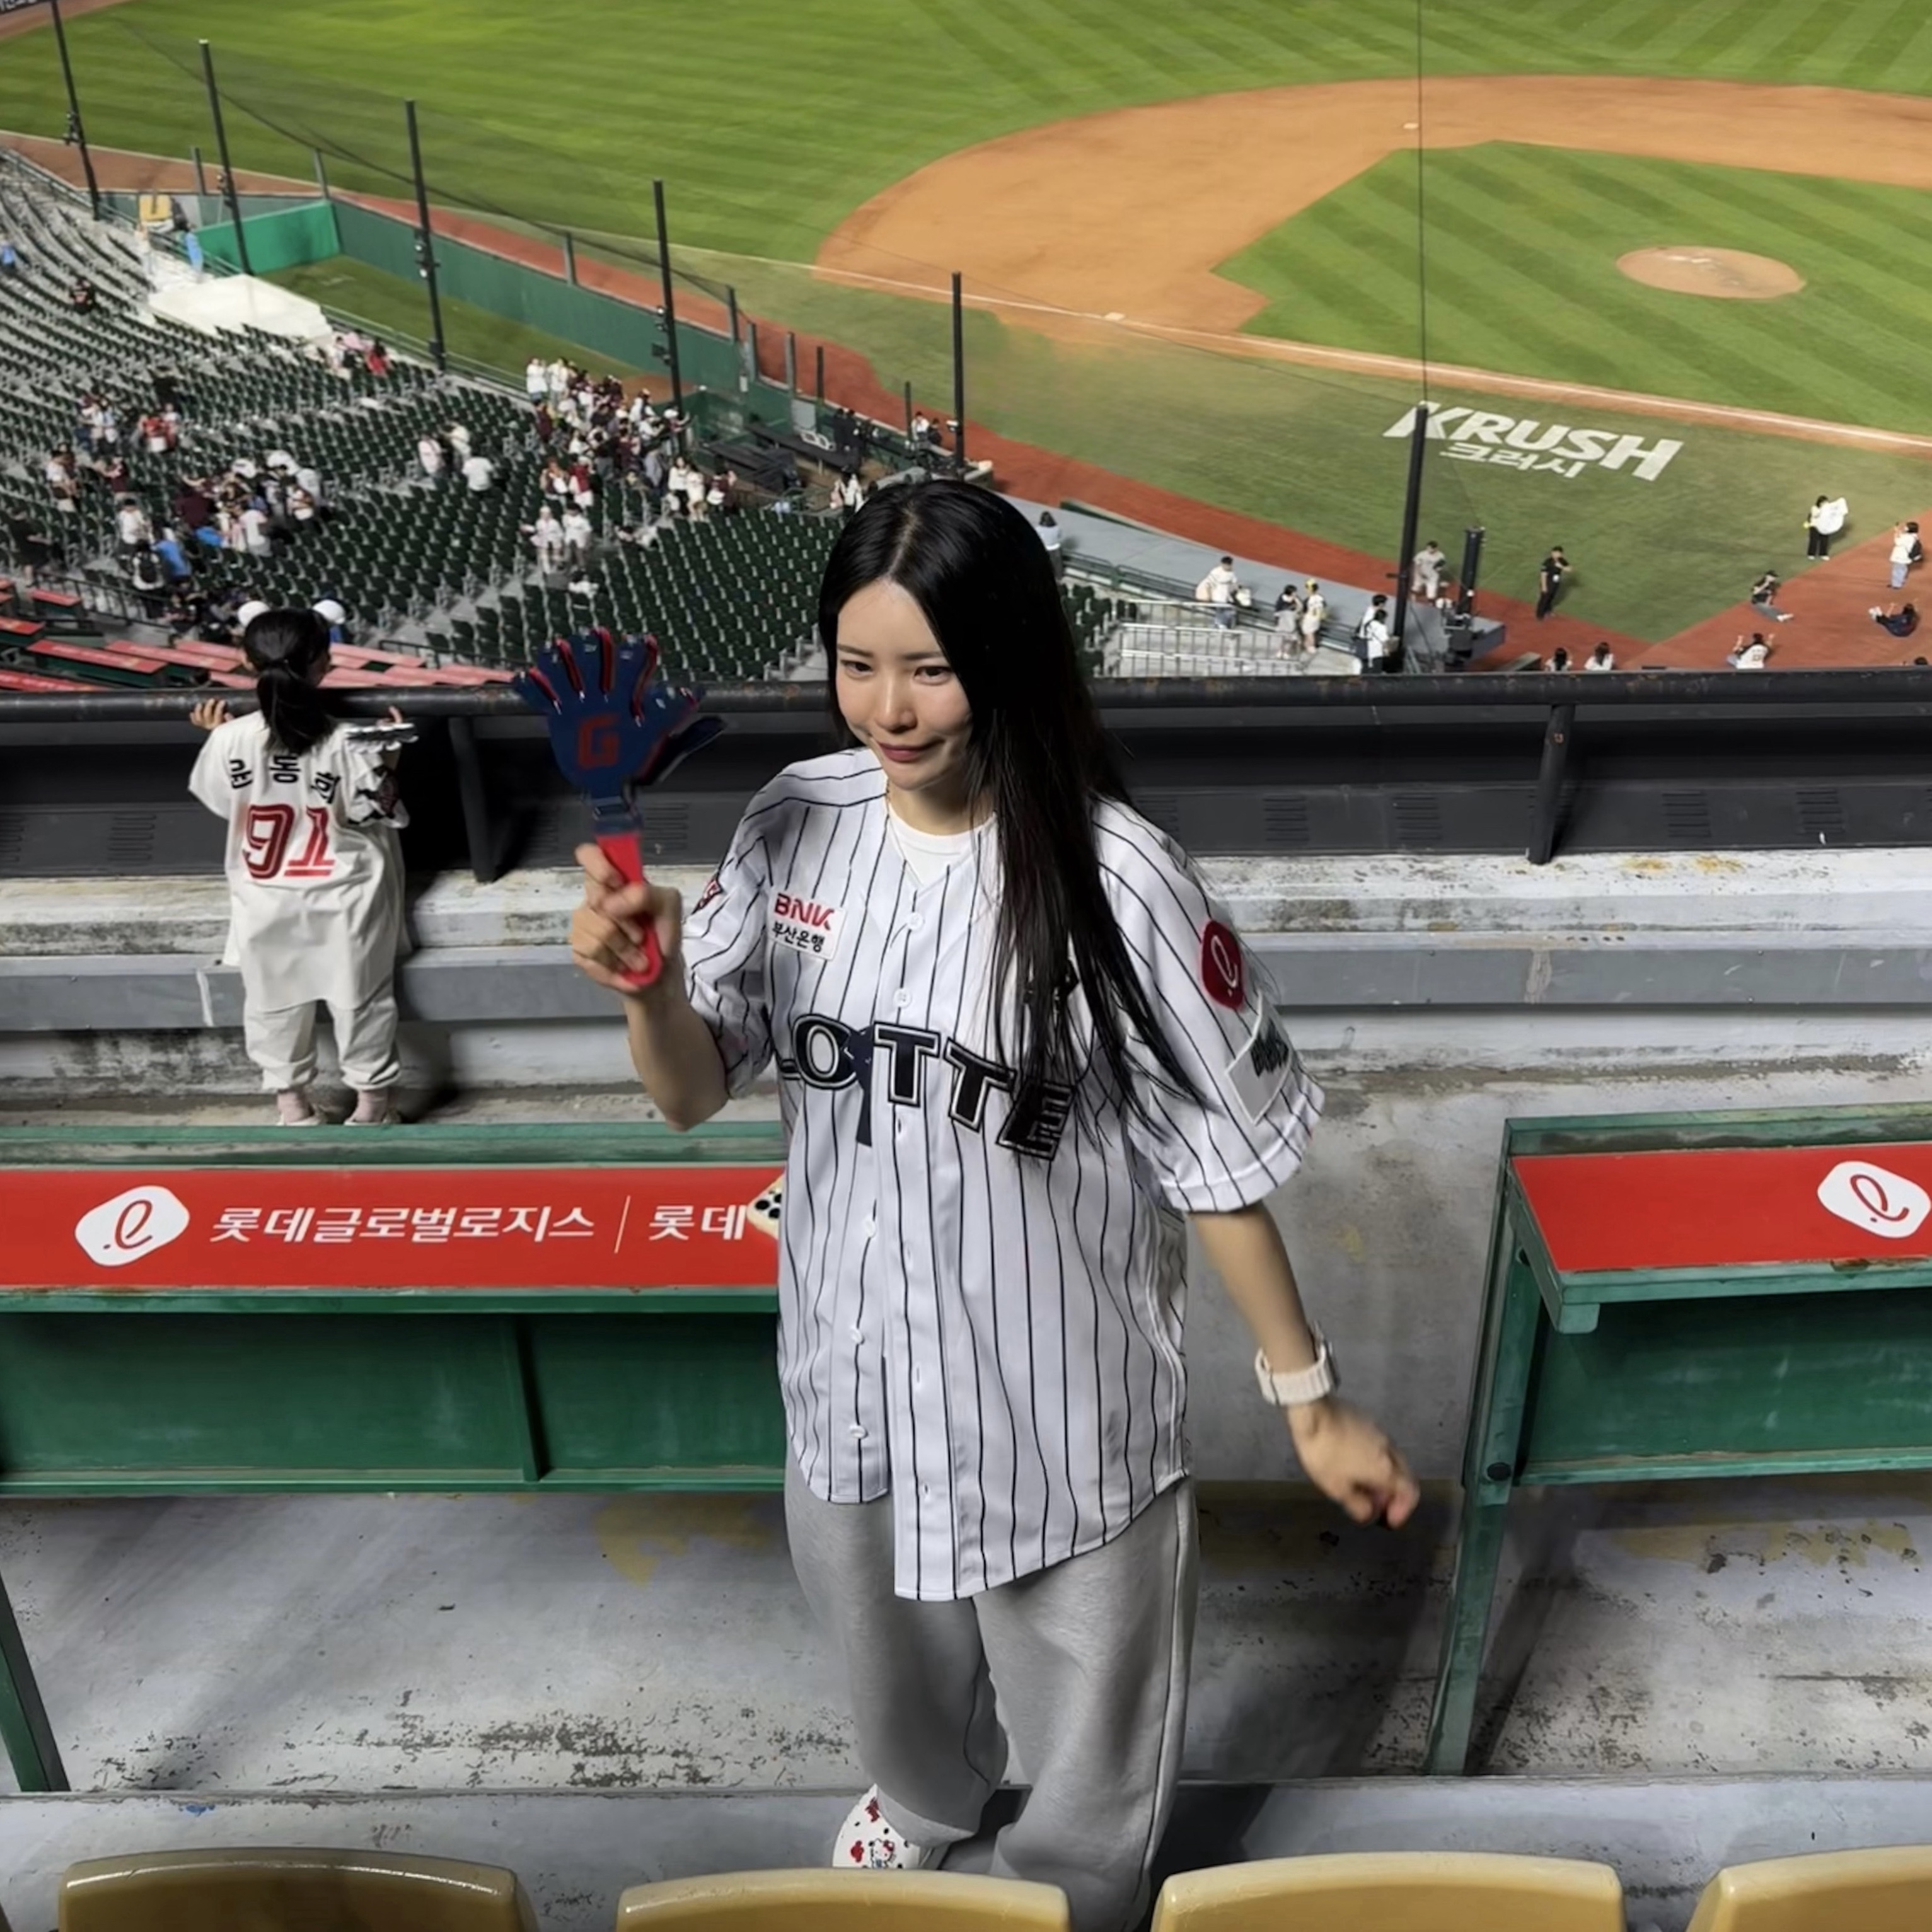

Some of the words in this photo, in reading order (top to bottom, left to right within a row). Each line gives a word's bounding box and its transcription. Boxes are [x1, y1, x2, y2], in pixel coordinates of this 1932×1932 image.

[1382, 400, 1684, 481] KRUSH
[1439, 443, 1586, 478] 크러시
[577, 714, 620, 770] G
[242, 804, 335, 879] 91
[774, 893, 835, 930] BNK
[772, 921, 825, 953] 부산은행
[780, 1013, 1075, 1160] OTTE
[209, 1206, 594, 1243] 롯데글로벌로지스
[649, 1205, 748, 1241] 롯데
